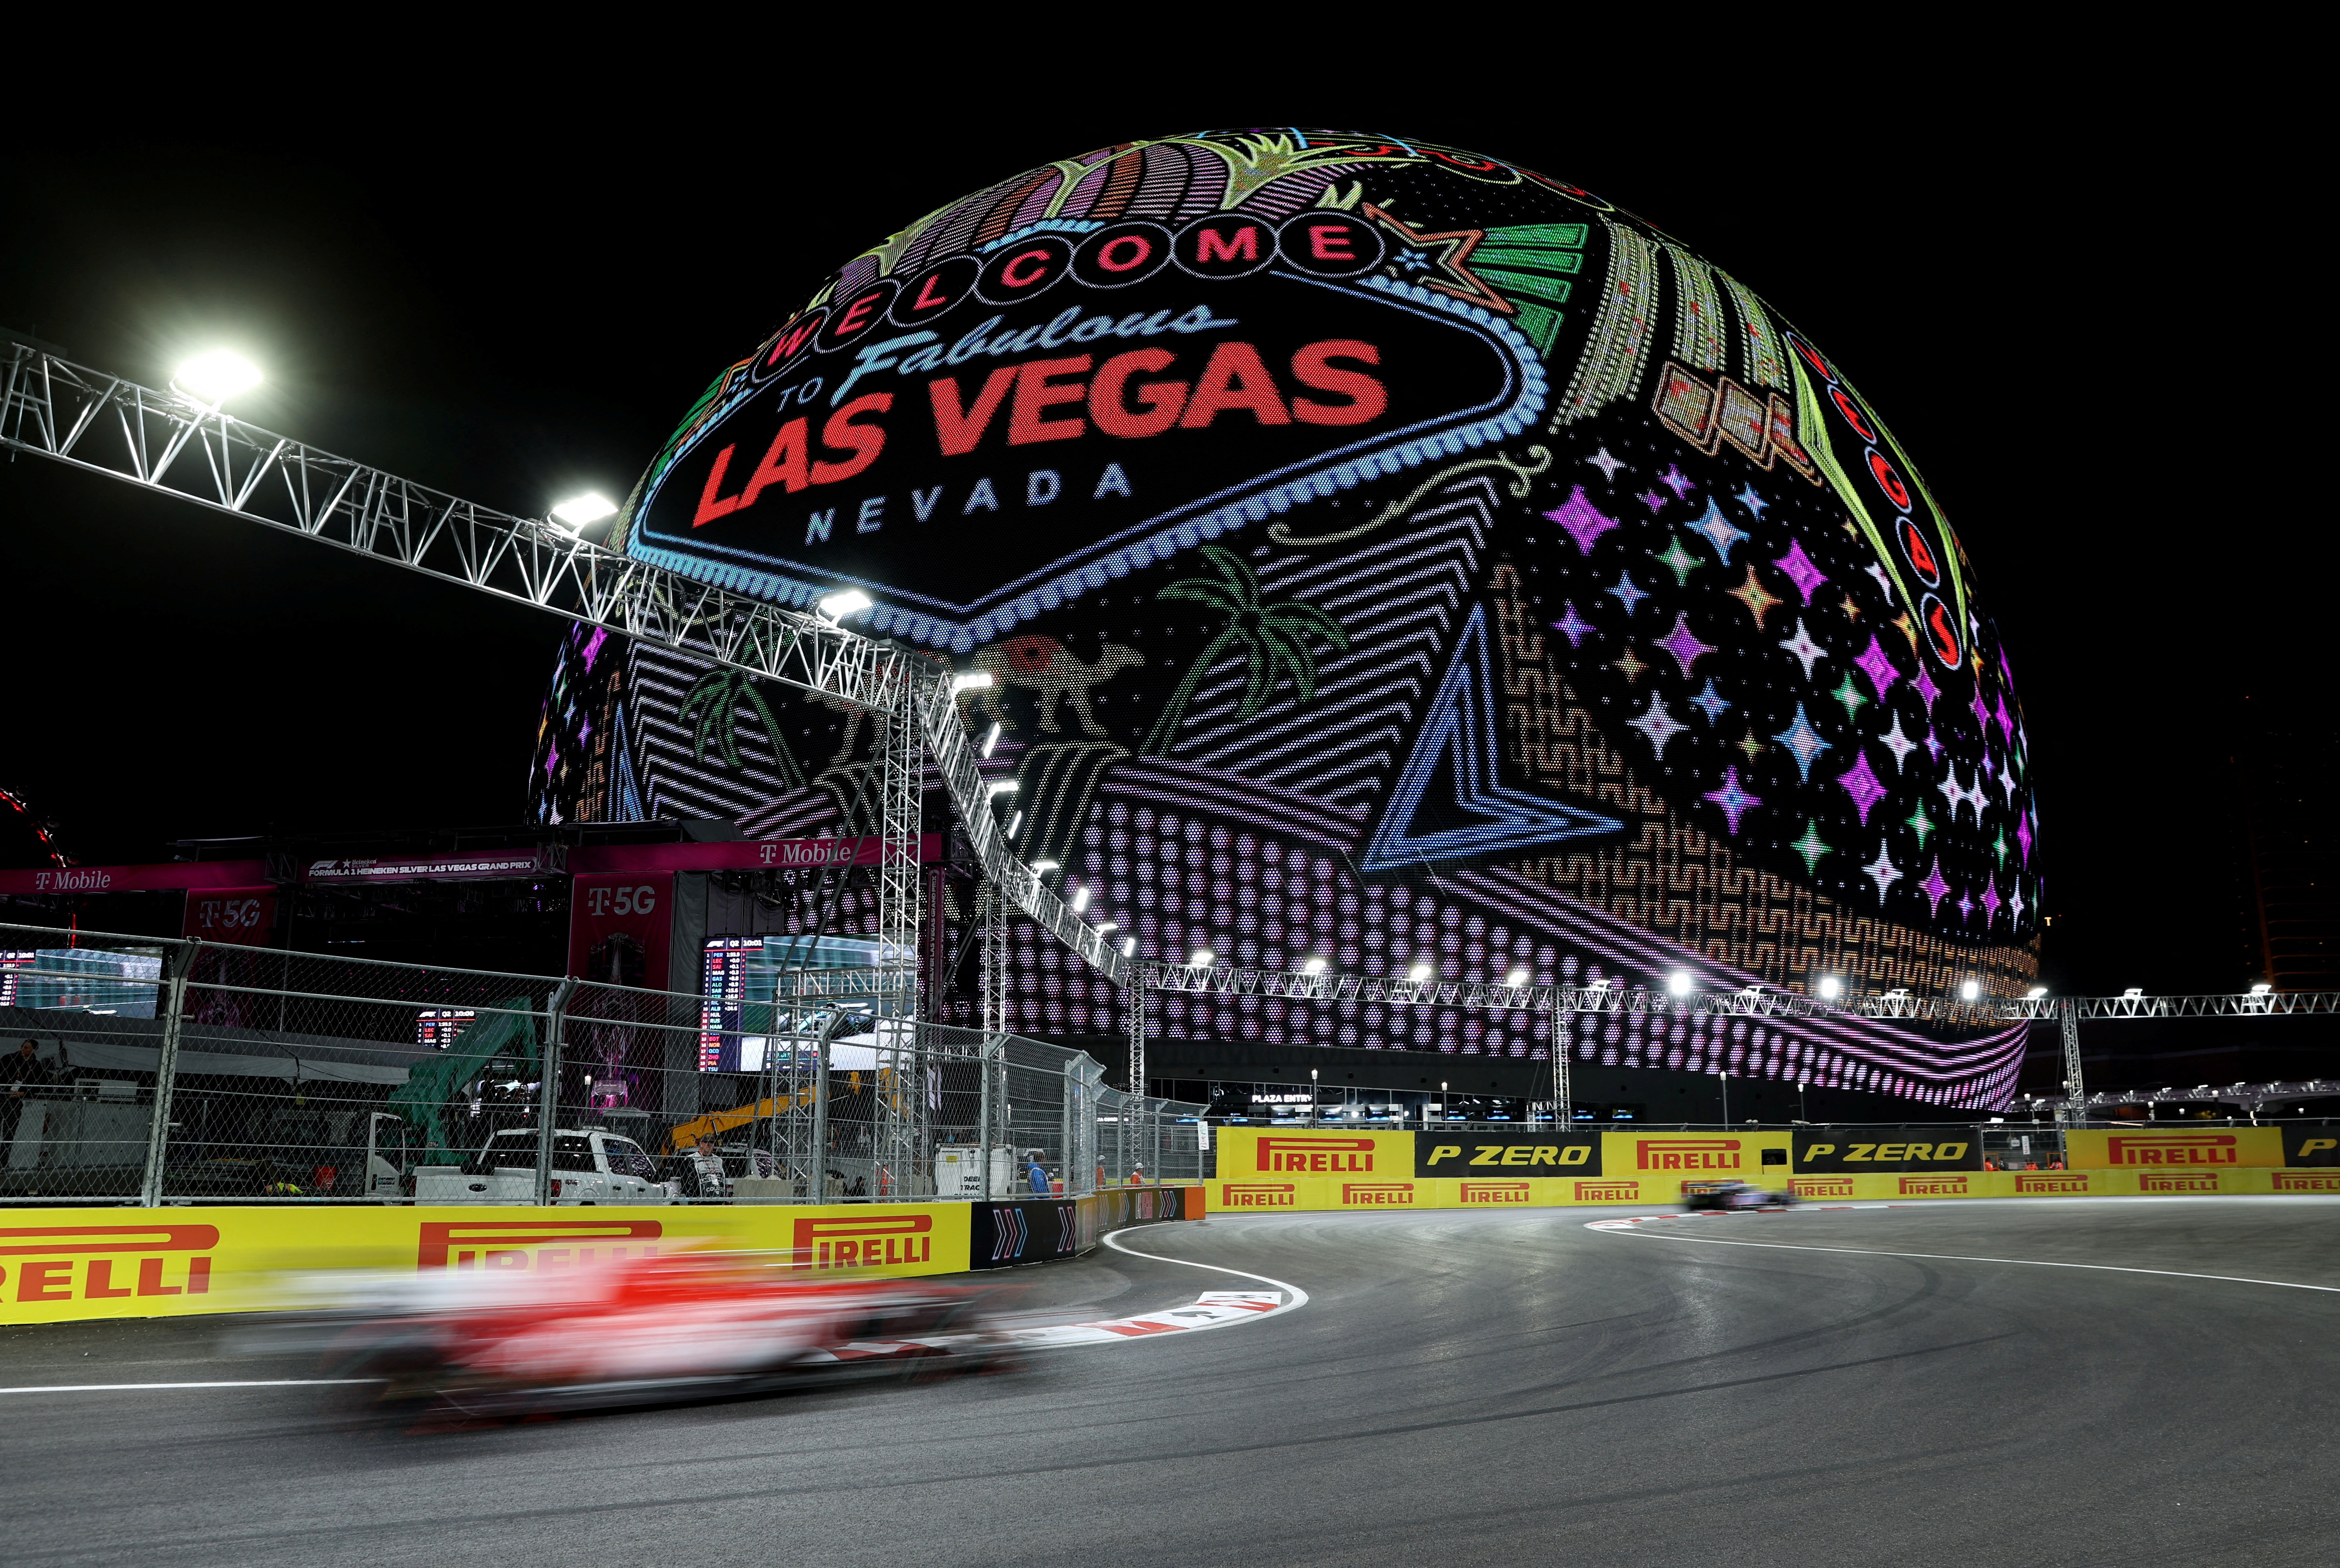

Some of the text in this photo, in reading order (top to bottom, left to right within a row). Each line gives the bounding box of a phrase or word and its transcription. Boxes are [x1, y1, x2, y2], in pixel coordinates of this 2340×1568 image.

[767, 225, 1357, 367] WELCOME
[777, 304, 1240, 413] TO Fabulous
[692, 339, 1388, 528] LAS VEGAS
[804, 463, 1132, 546] NEVADA
[782, 843, 851, 863] Mobile
[53, 870, 110, 889] Mobile
[614, 885, 655, 915] 5G
[222, 898, 261, 928] 5G
[1252, 1094, 1313, 1103] PLAZA ENTRY
[1257, 1137, 1375, 1171] PIRELLI
[1427, 1146, 1592, 1165] P ZERO
[1637, 1140, 1741, 1169] PIRELLI
[1803, 1142, 1968, 1162] P ZERO
[2108, 1135, 2237, 1164] PIRELLI
[2298, 1139, 2338, 1156] P
[1575, 1181, 1639, 1201] PIRELLI
[1788, 1178, 1853, 1196] PIRELLI
[1899, 1176, 1968, 1195] PIRELLI
[2015, 1174, 2088, 1193] PIRELLI
[2140, 1173, 2218, 1191] PIRELLI
[2272, 1172, 2340, 1190] PIREL
[1223, 1184, 1294, 1206] PIRELLI
[1343, 1183, 1414, 1204] PIRELLI
[1460, 1182, 1530, 1203] PIRELLI
[792, 1215, 932, 1270] PIRELLI
